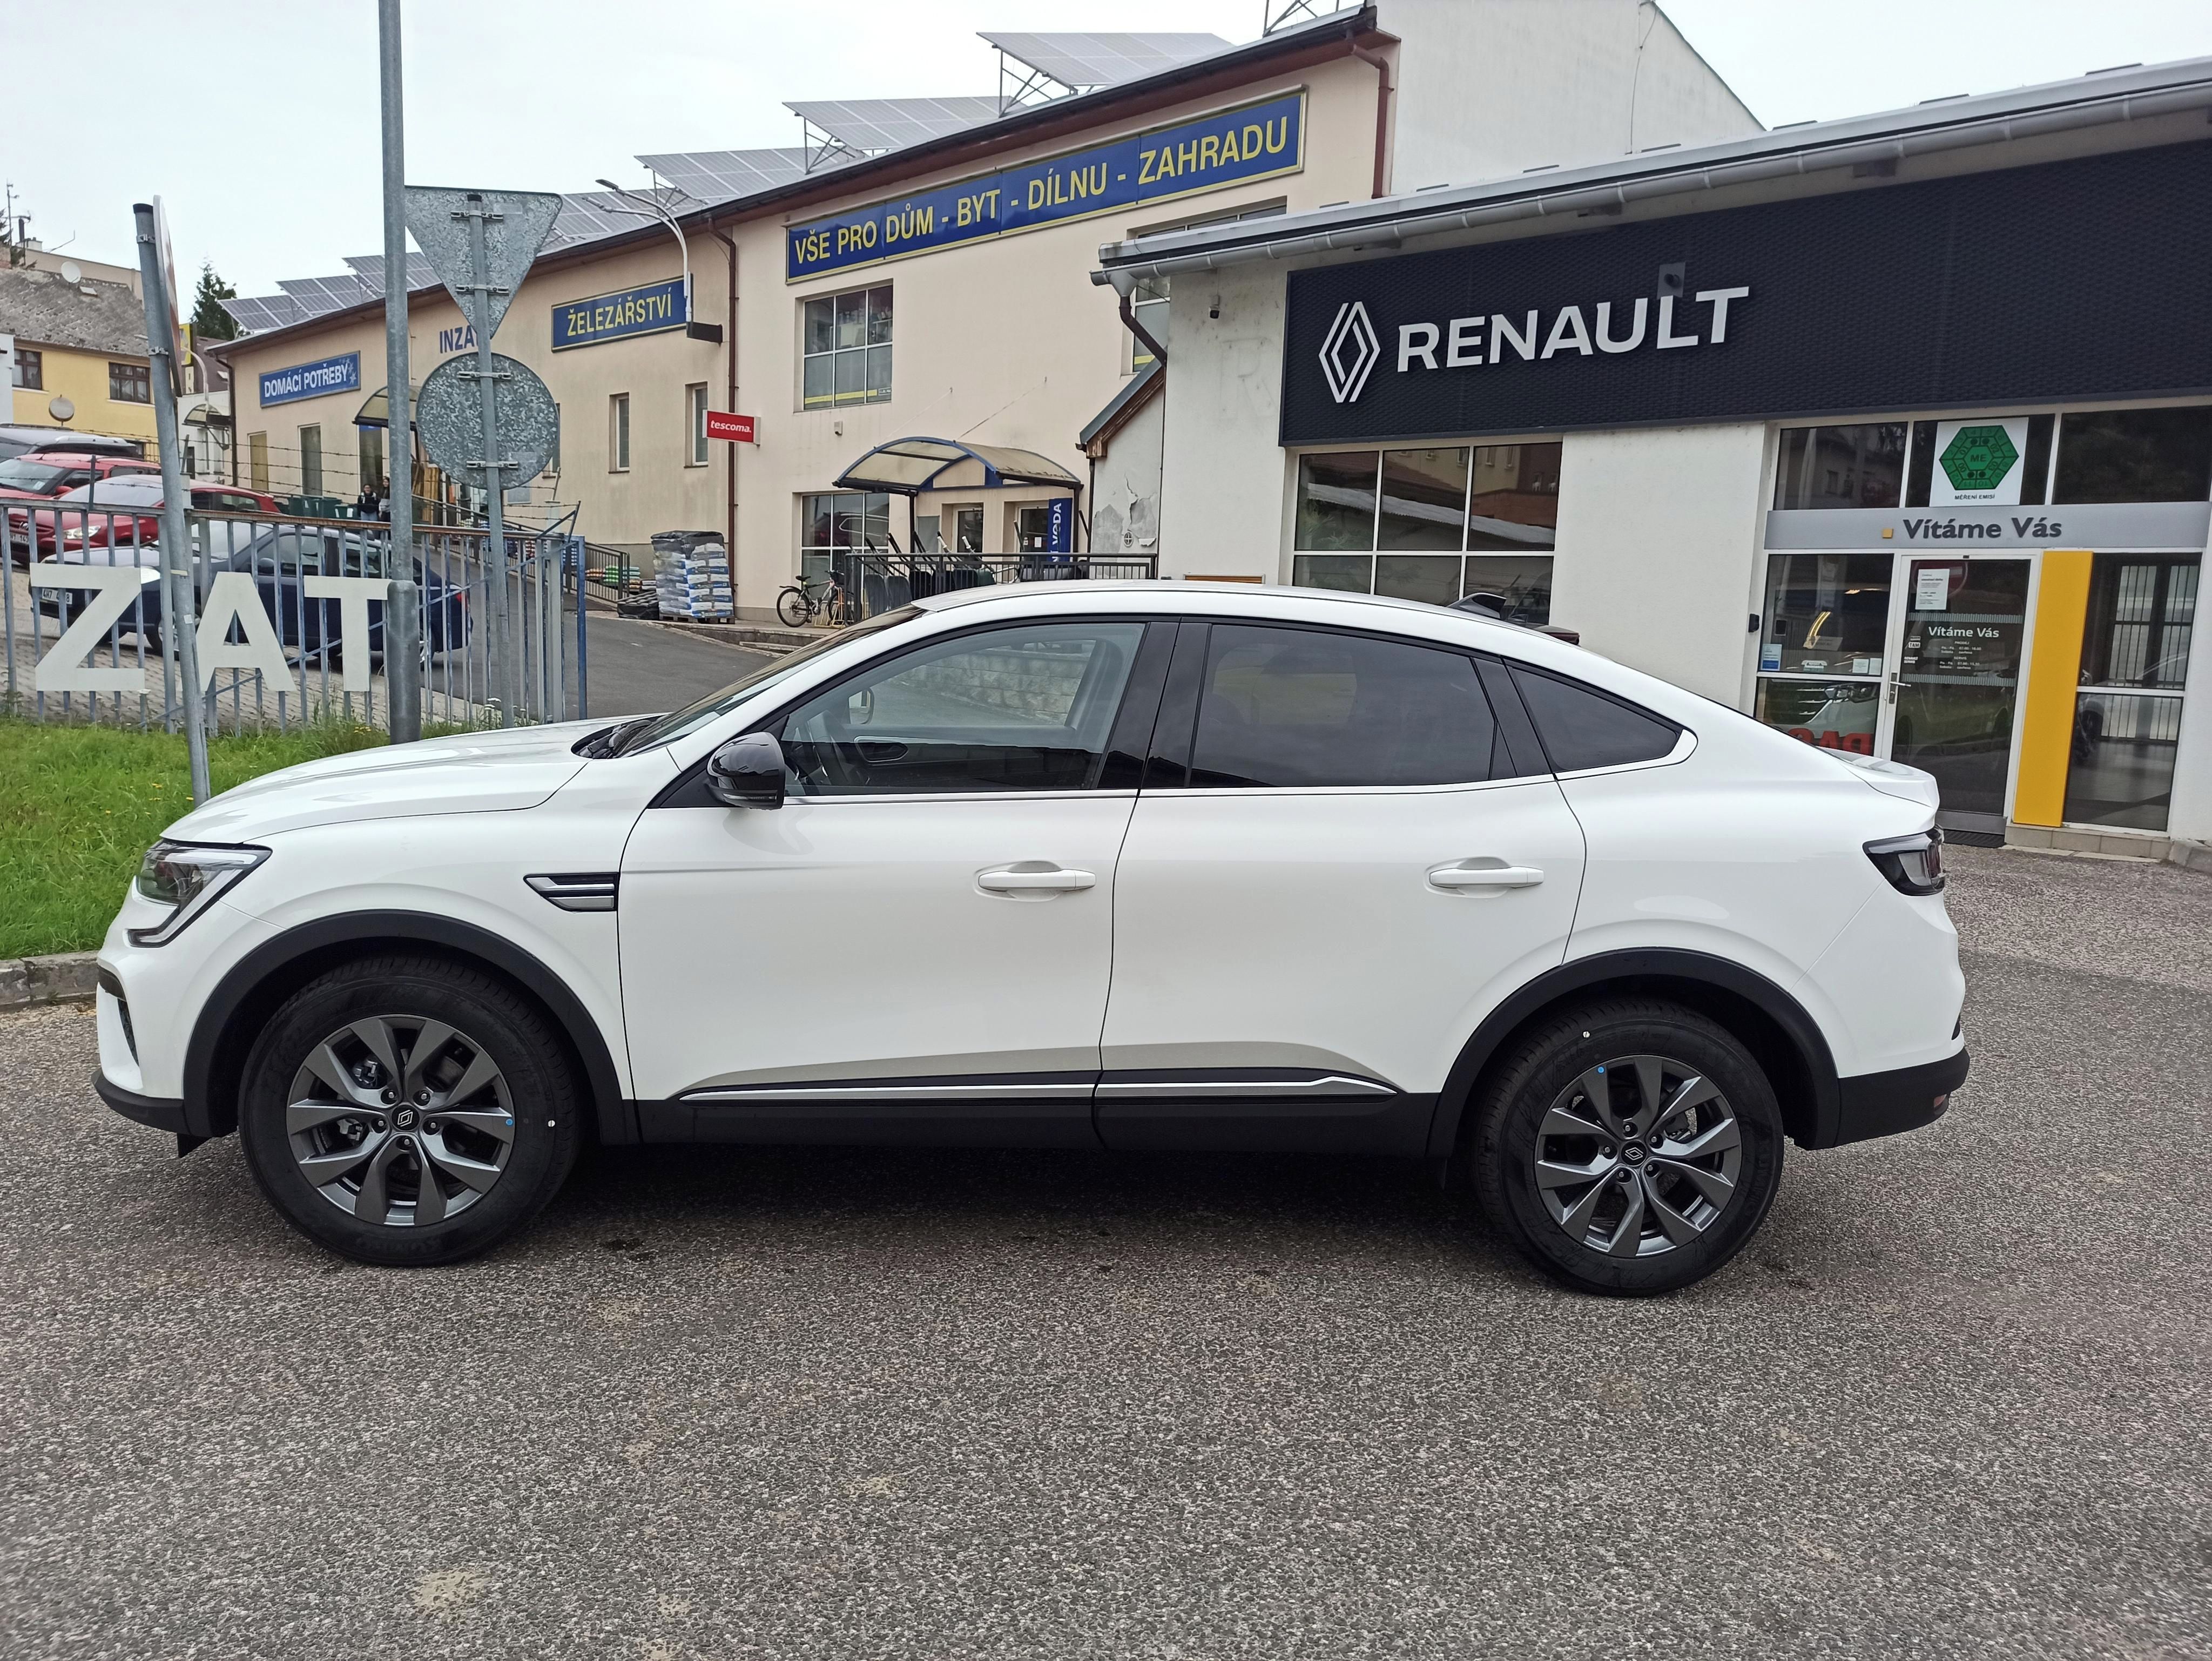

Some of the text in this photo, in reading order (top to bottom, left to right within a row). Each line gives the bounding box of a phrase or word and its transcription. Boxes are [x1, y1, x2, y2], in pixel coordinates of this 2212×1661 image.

[795, 229, 831, 264] VŠE
[838, 220, 877, 254] PRO
[886, 202, 933, 242] DŮM
[957, 188, 1001, 227] BYT
[1028, 162, 1107, 210] DÍLNU
[1138, 116, 1287, 185] ZAHRADU
[567, 287, 672, 337] ŽELEZÁŘSTVÍ
[1397, 286, 1750, 373] RENAULT
[440, 325, 478, 354] INZA
[264, 362, 348, 397] DOMÁCÍ POTŘEBY
[1970, 454, 1987, 463] ME
[1903, 517, 2062, 539] Vítáme Vás
[30, 563, 393, 692] ZAT
[1928, 626, 2000, 638] Vítáme Vás
